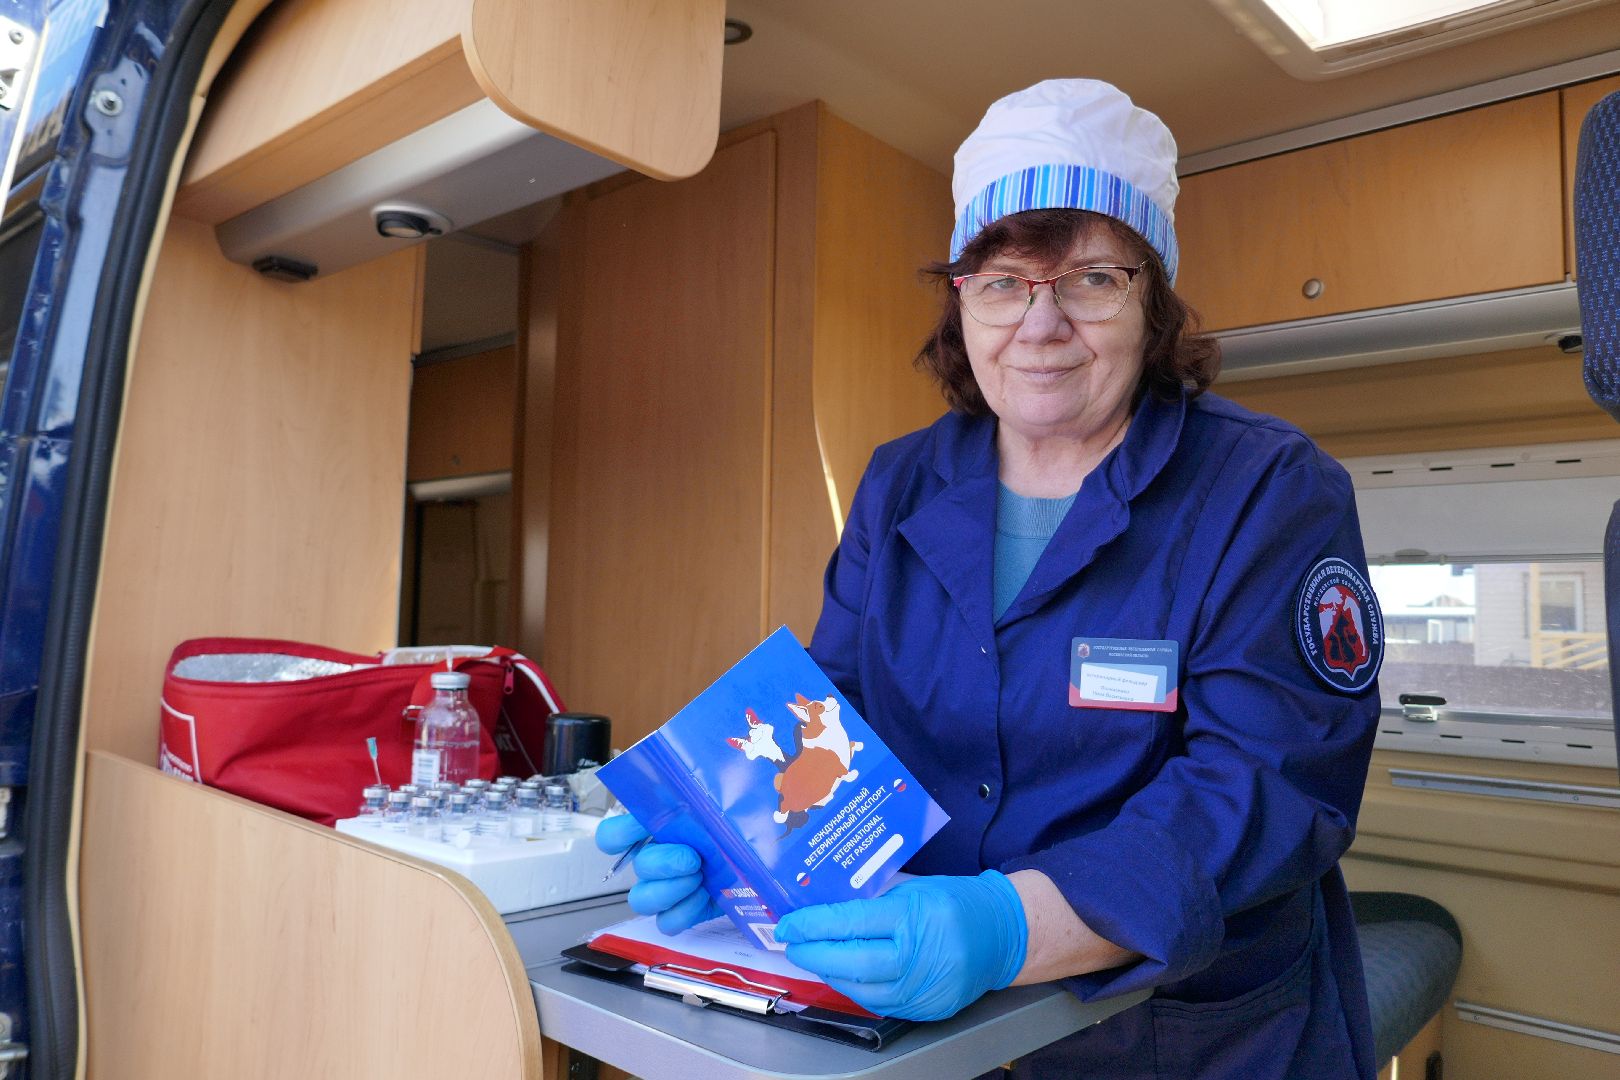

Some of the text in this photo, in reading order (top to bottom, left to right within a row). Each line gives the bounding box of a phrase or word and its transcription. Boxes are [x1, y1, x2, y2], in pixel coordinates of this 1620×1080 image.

[1302, 565, 1379, 657] ГОСУДАРСТВЕННАЯ ВЕТЕРИНАРНАЯ СЛУЖБА
[803, 785, 887, 867] ВЕТЕРИНАРНЫЙ ПАСПОРТ
[807, 786, 870, 848] МЕЖДУНАРОДНЫЙ
[832, 813, 883, 862] INTERNATIONAL
[840, 822, 888, 869] PET PASSPORT
